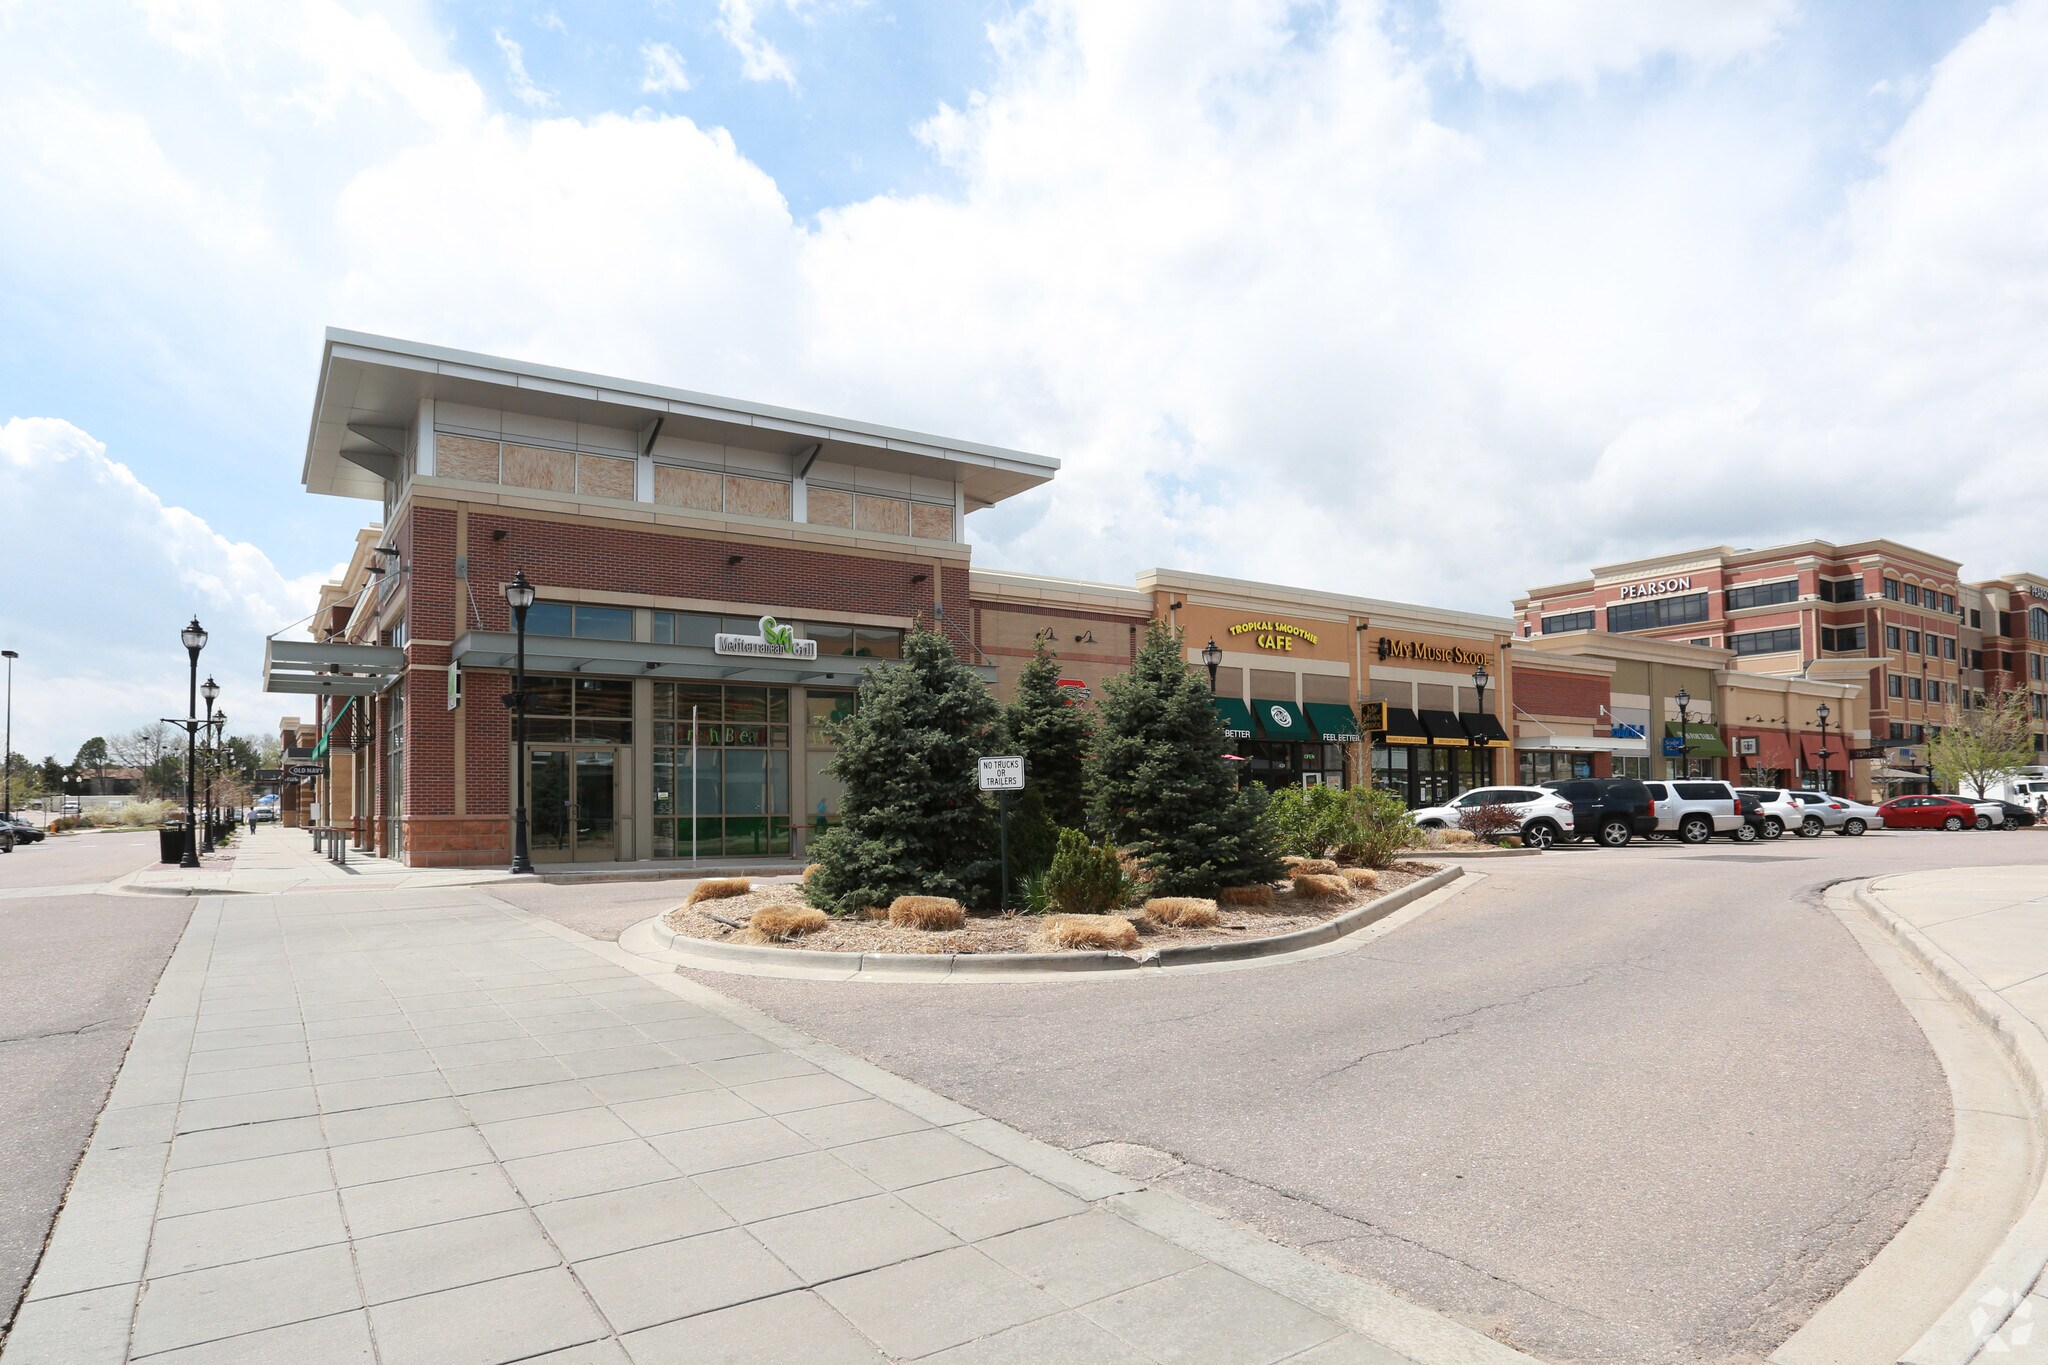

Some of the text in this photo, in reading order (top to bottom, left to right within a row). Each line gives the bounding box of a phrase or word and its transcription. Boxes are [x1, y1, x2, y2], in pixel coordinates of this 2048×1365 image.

[1620, 576, 1690, 599] PEARSON
[2031, 585, 2048, 601] PEARS
[1229, 621, 1318, 645] TROPICAL SMOOTHIE
[719, 637, 816, 657] Mediterranean Grill
[1257, 634, 1292, 651] CAFE
[679, 727, 719, 743] Frsh
[1224, 729, 1251, 738] BETTER
[1322, 733, 1338, 741] FEEL
[983, 760, 1019, 769] NO TRUCKS
[986, 776, 1017, 786] TRAILERS
[996, 769, 1006, 777] OR
